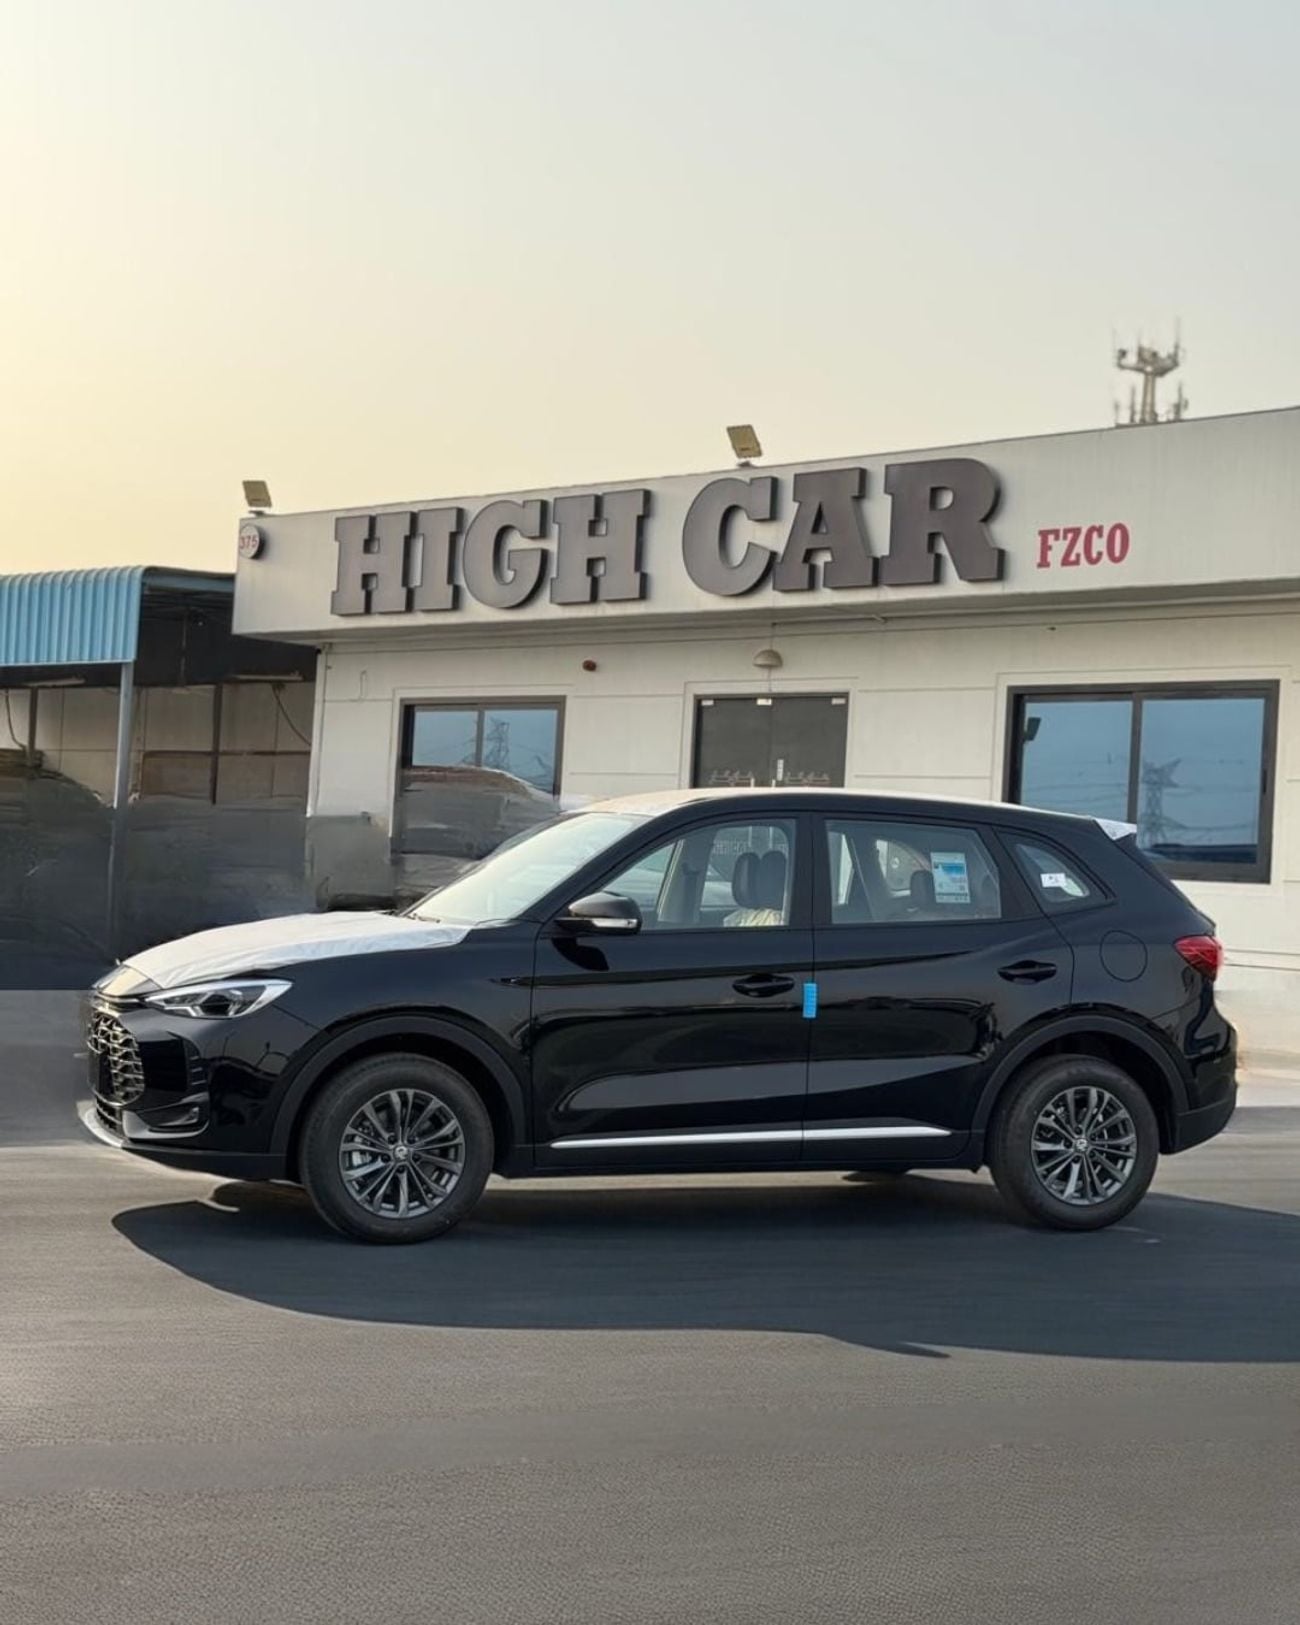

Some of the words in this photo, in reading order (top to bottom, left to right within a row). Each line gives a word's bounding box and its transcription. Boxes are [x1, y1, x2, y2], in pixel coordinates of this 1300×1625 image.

[331, 489, 652, 615] HIGH
[683, 458, 1004, 597] CAR
[1037, 522, 1130, 568] FZCO
